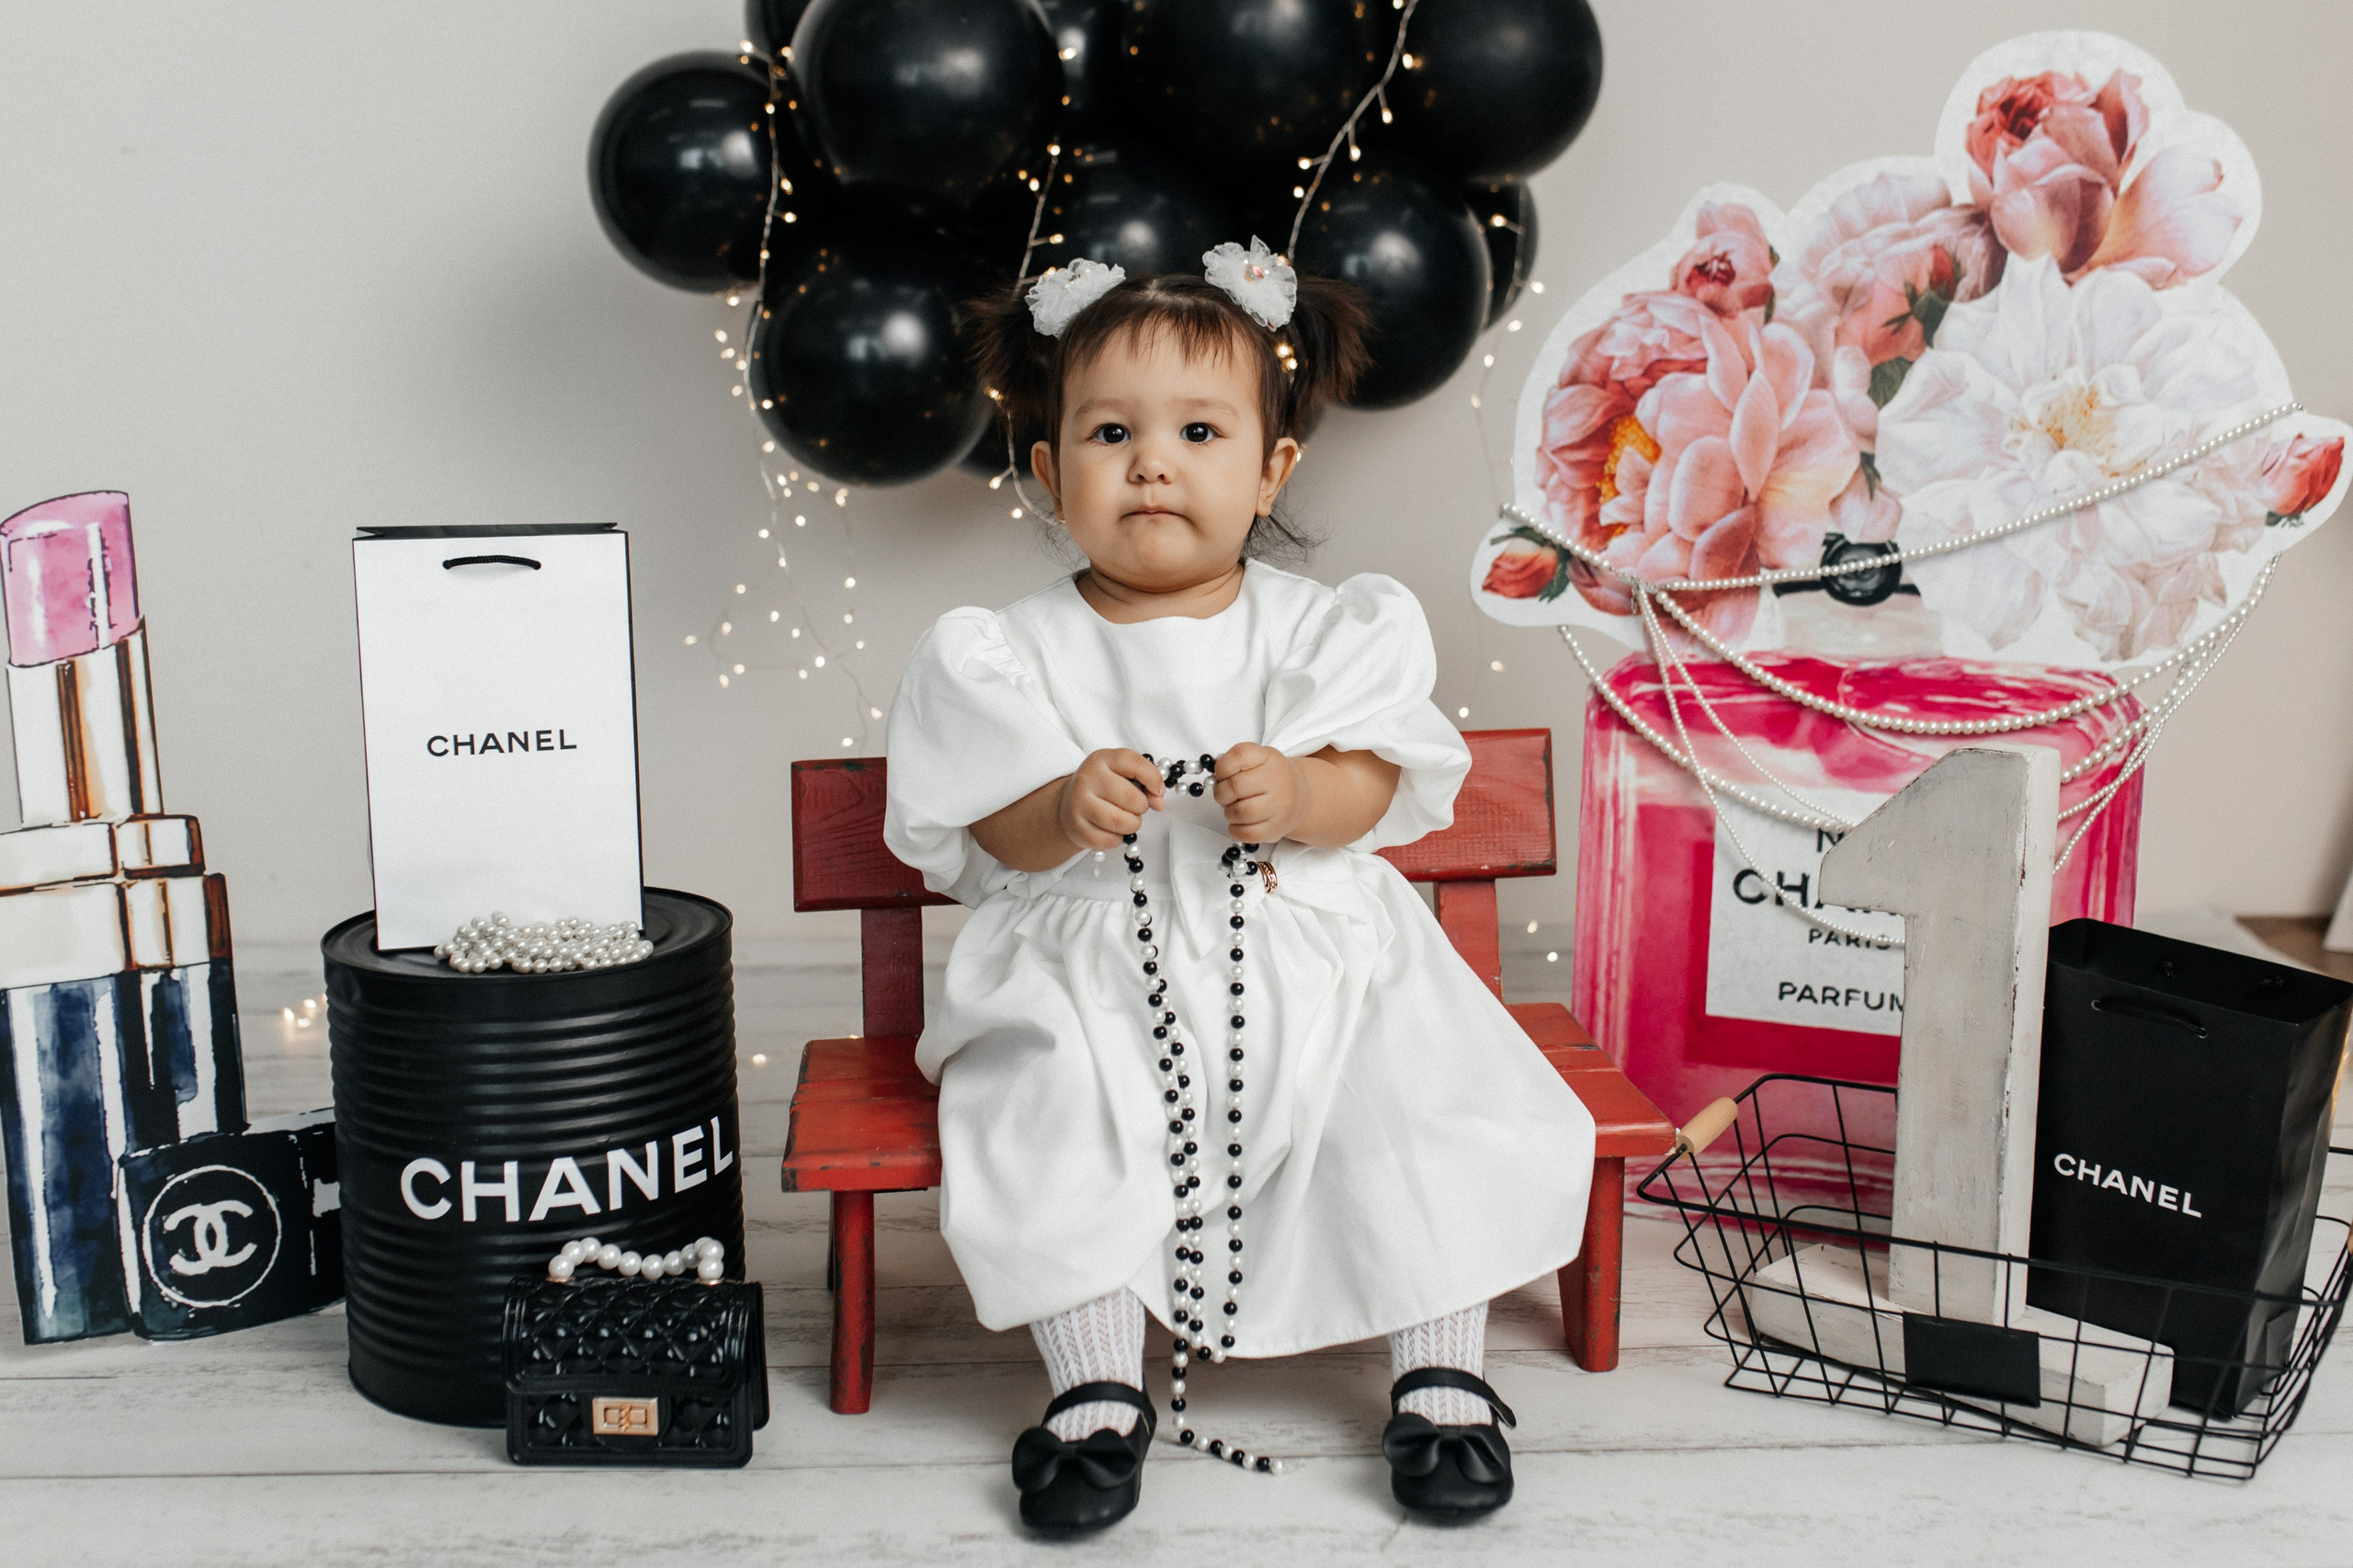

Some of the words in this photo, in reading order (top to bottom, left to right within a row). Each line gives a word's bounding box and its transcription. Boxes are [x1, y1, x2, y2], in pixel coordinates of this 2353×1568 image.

[426, 729, 577, 757] CHANEL
[400, 1115, 733, 1223] CHANEL
[2053, 1153, 2202, 1219] CHANEL
